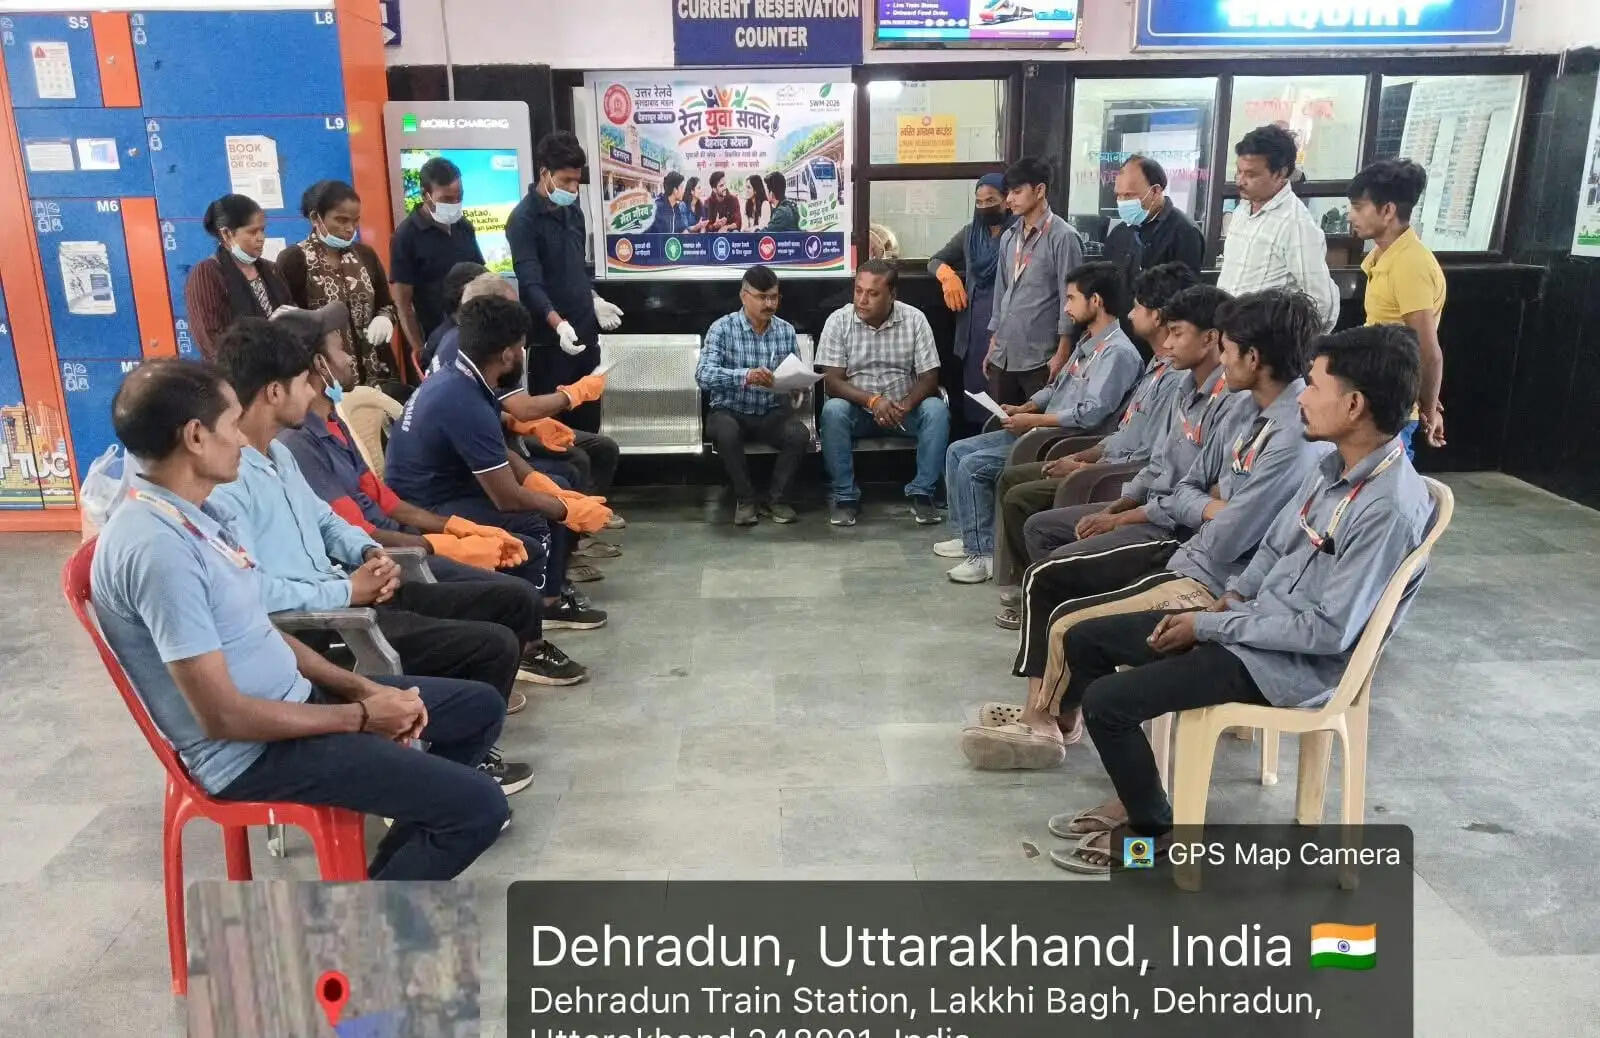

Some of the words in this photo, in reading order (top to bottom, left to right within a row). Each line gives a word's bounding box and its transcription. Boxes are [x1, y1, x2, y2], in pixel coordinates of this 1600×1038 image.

[677, 0, 751, 18] CURRENT
[755, 0, 859, 18] RESERVATION
[68, 15, 89, 29] S5
[314, 11, 334, 25] L8
[734, 26, 808, 49] COUNTER
[634, 88, 652, 98] उत्तर
[654, 84, 673, 98] रेलवे
[809, 99, 825, 107] SWM
[325, 118, 345, 130] L9
[420, 118, 455, 129] MOBILE
[456, 118, 510, 130] CHARGING
[678, 108, 702, 136] रेल
[704, 109, 733, 136] युवा
[735, 106, 771, 133] संवाद
[228, 143, 262, 153] BOOK
[230, 153, 254, 161] using
[97, 200, 119, 213] M6
